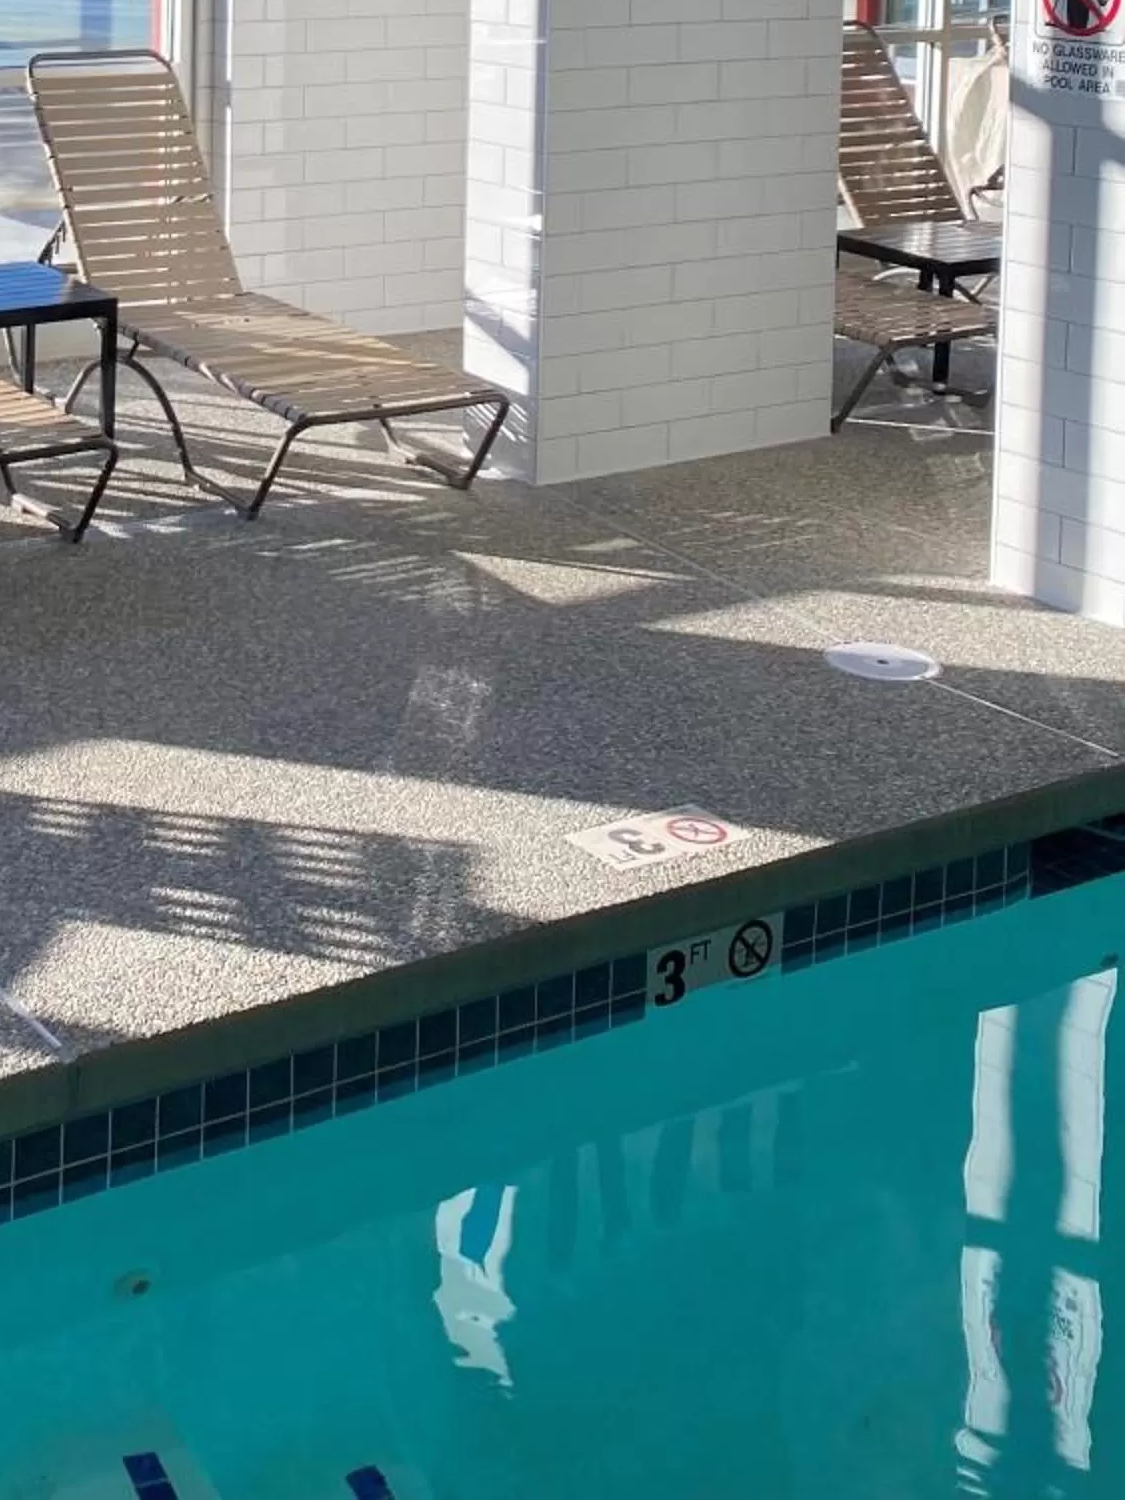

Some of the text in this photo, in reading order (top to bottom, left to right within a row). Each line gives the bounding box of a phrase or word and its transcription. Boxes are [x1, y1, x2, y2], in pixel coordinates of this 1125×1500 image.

[1032, 41, 1125, 64] NO GLASSWARE
[1042, 59, 1114, 79] ALLOWED IN
[1043, 74, 1073, 91] POOL
[1078, 79, 1110, 93] AREA
[607, 828, 665, 855] 3
[654, 939, 711, 1007] 3 FT
